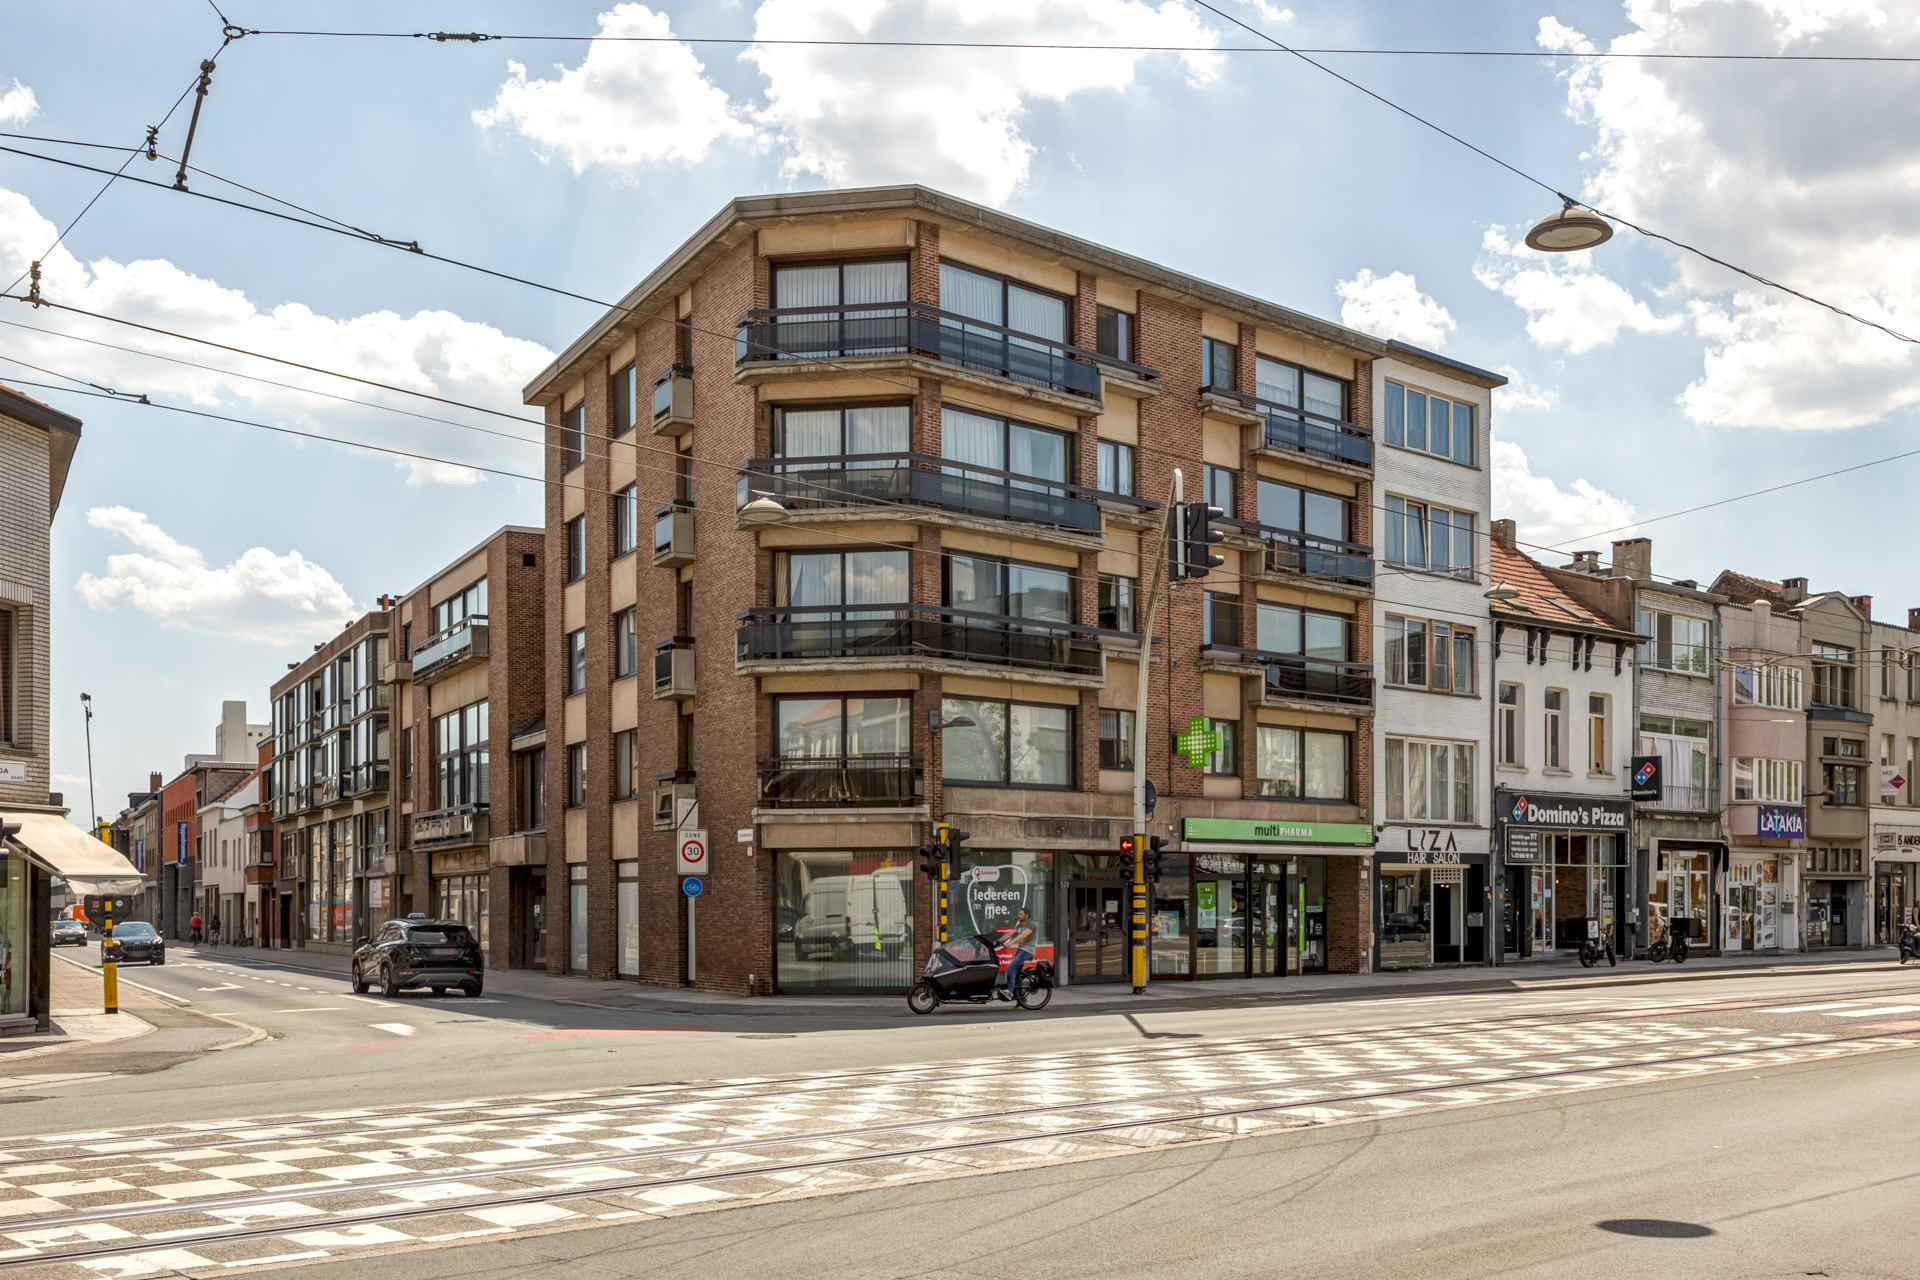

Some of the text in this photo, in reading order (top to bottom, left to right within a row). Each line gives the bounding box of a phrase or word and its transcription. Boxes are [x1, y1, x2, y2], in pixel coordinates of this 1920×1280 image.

[1527, 804, 1625, 826] Domino's Pizza
[1761, 814, 1803, 833] LATAKIA
[1407, 829, 1458, 852] LIZA
[687, 846, 700, 856] 30
[1407, 852, 1460, 864] HAIR SALON
[974, 887, 1020, 900] Iedereen
[985, 904, 1010, 915] mee.
